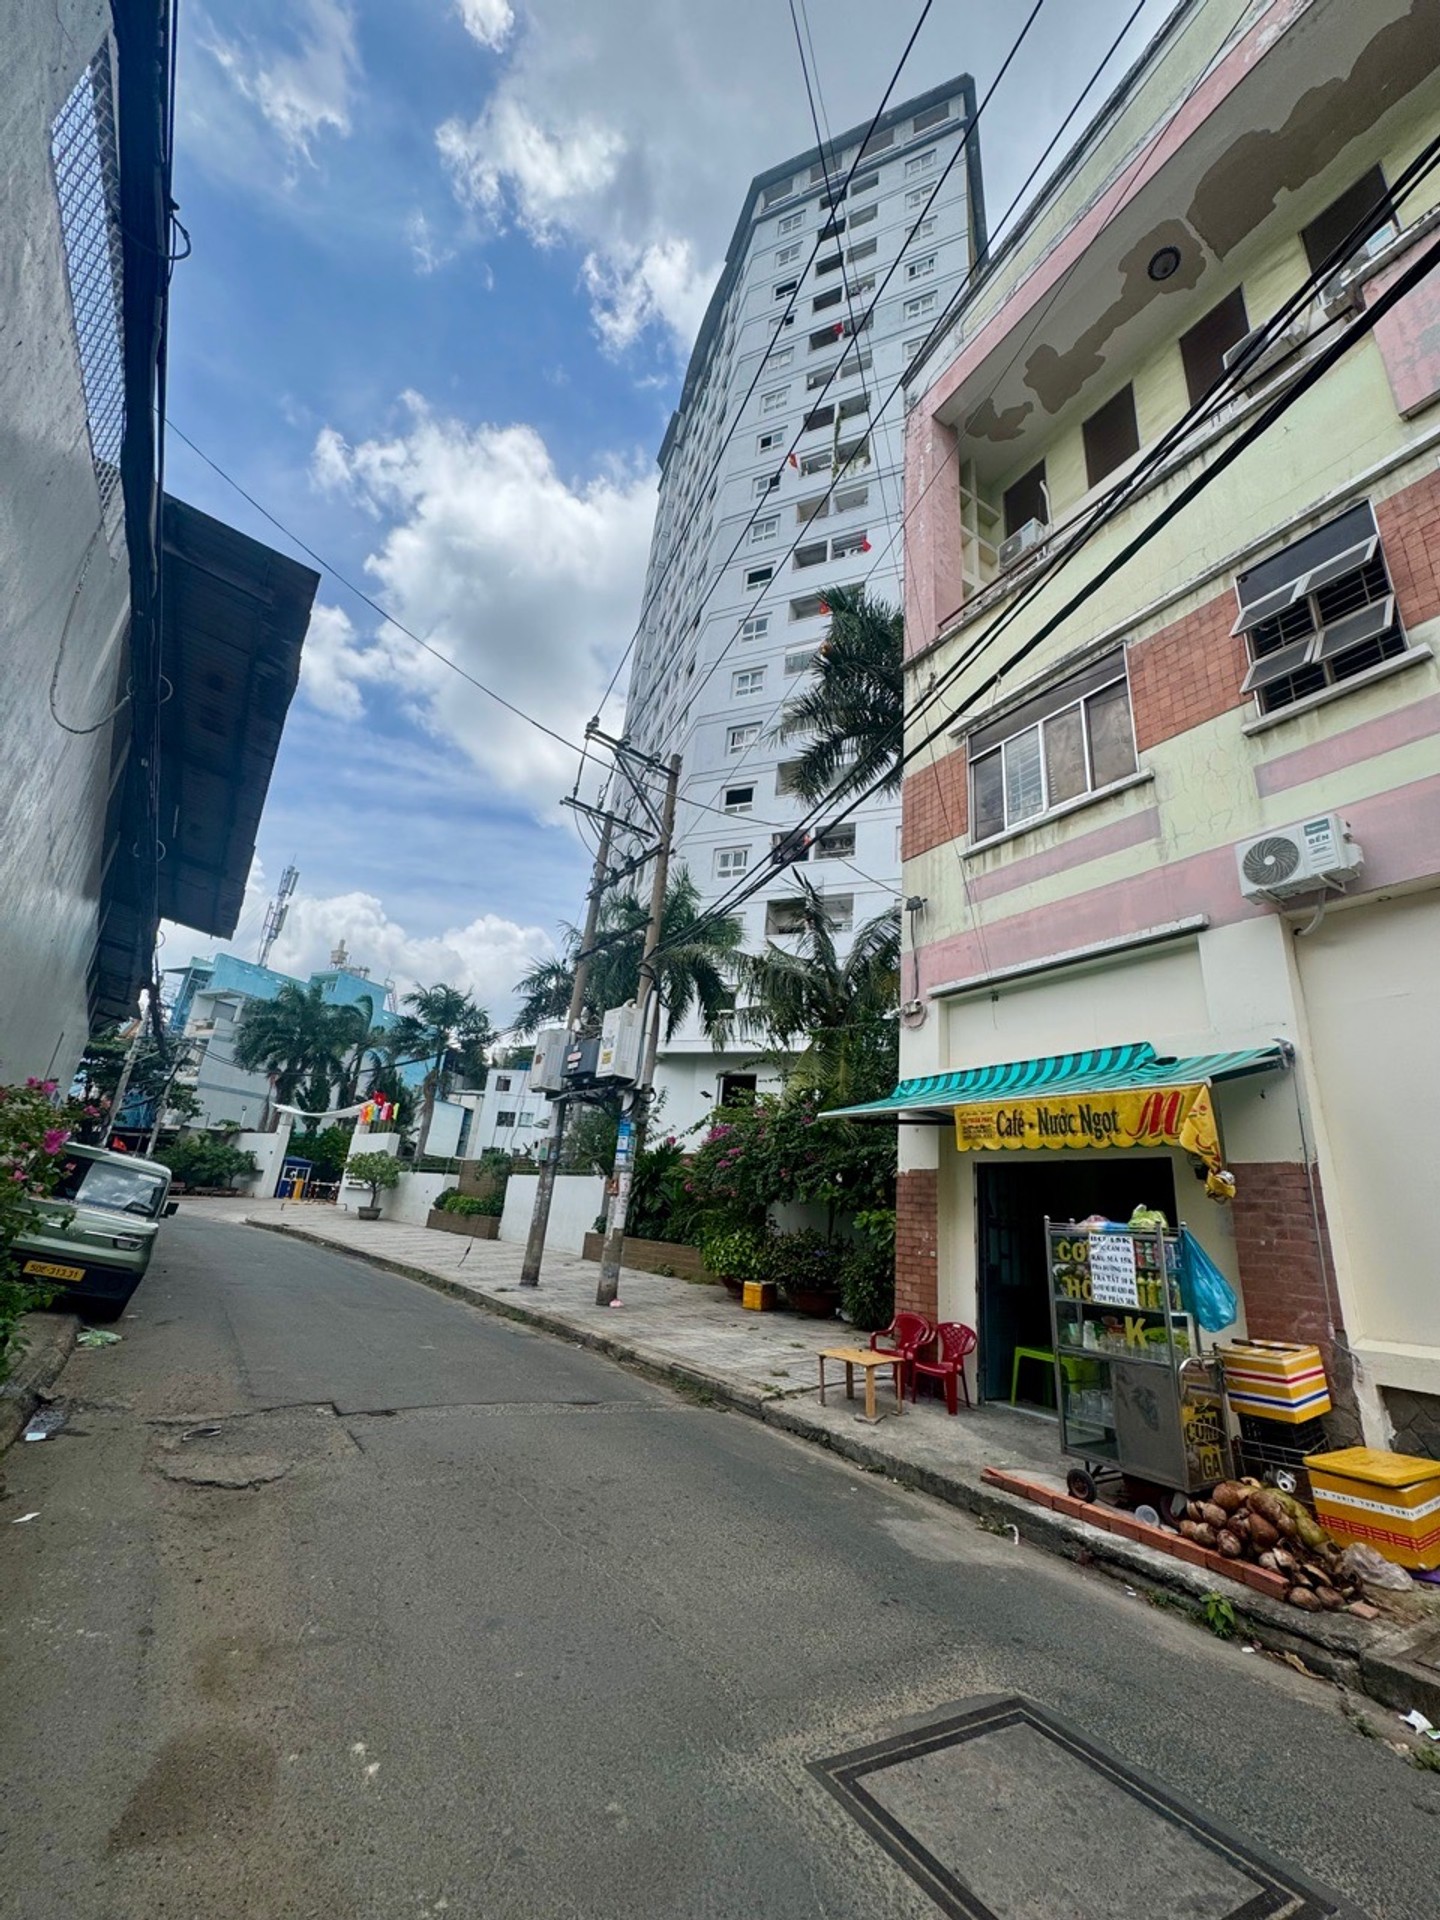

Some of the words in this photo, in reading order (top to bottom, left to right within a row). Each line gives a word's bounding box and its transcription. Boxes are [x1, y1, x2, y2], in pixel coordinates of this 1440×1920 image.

[996, 1109, 1025, 1138] Café
[1037, 1106, 1077, 1135] Nước
[1078, 1103, 1120, 1141] Ngọt
[1058, 1240, 1090, 1262] CƠ
